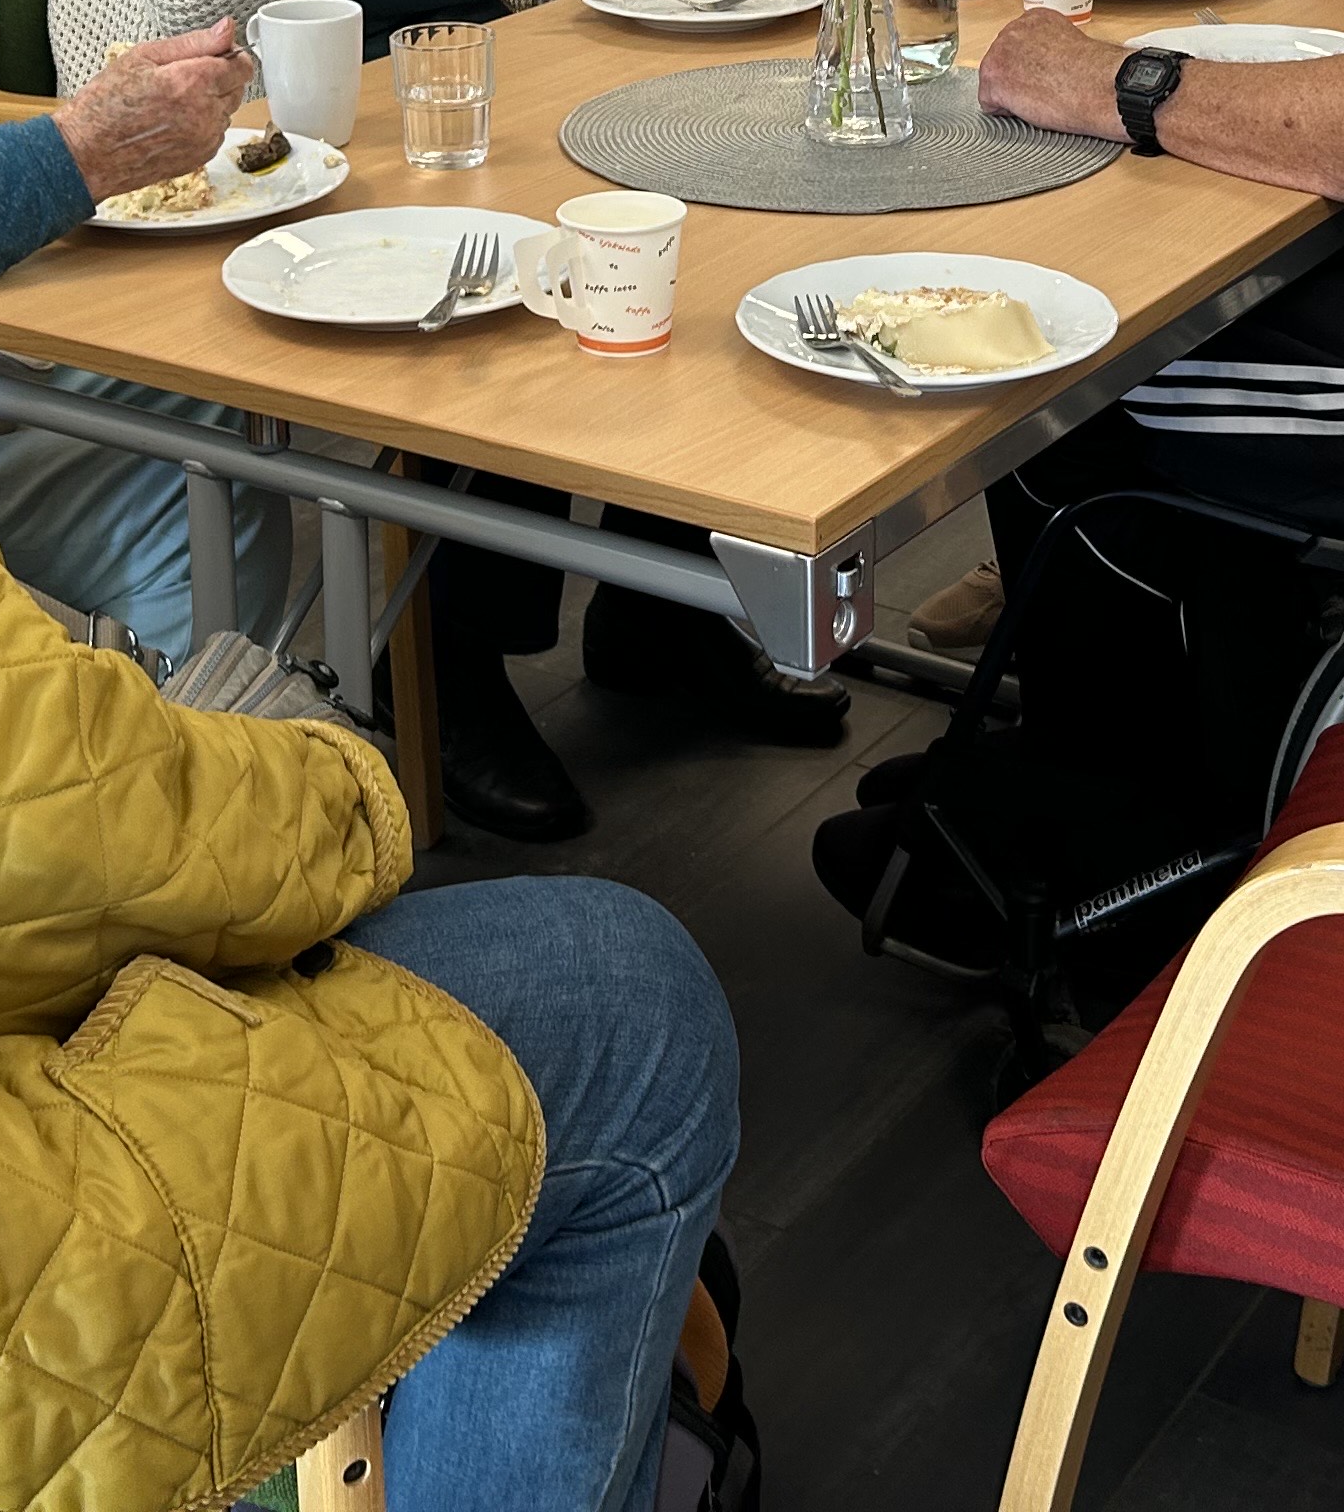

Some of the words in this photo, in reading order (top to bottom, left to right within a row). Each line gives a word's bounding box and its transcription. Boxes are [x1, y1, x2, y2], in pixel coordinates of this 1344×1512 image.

[585, 283, 608, 294] kaffe
[625, 305, 651, 316] kaffe
[592, 322, 615, 333] juice
[1074, 849, 1203, 930] panthera
